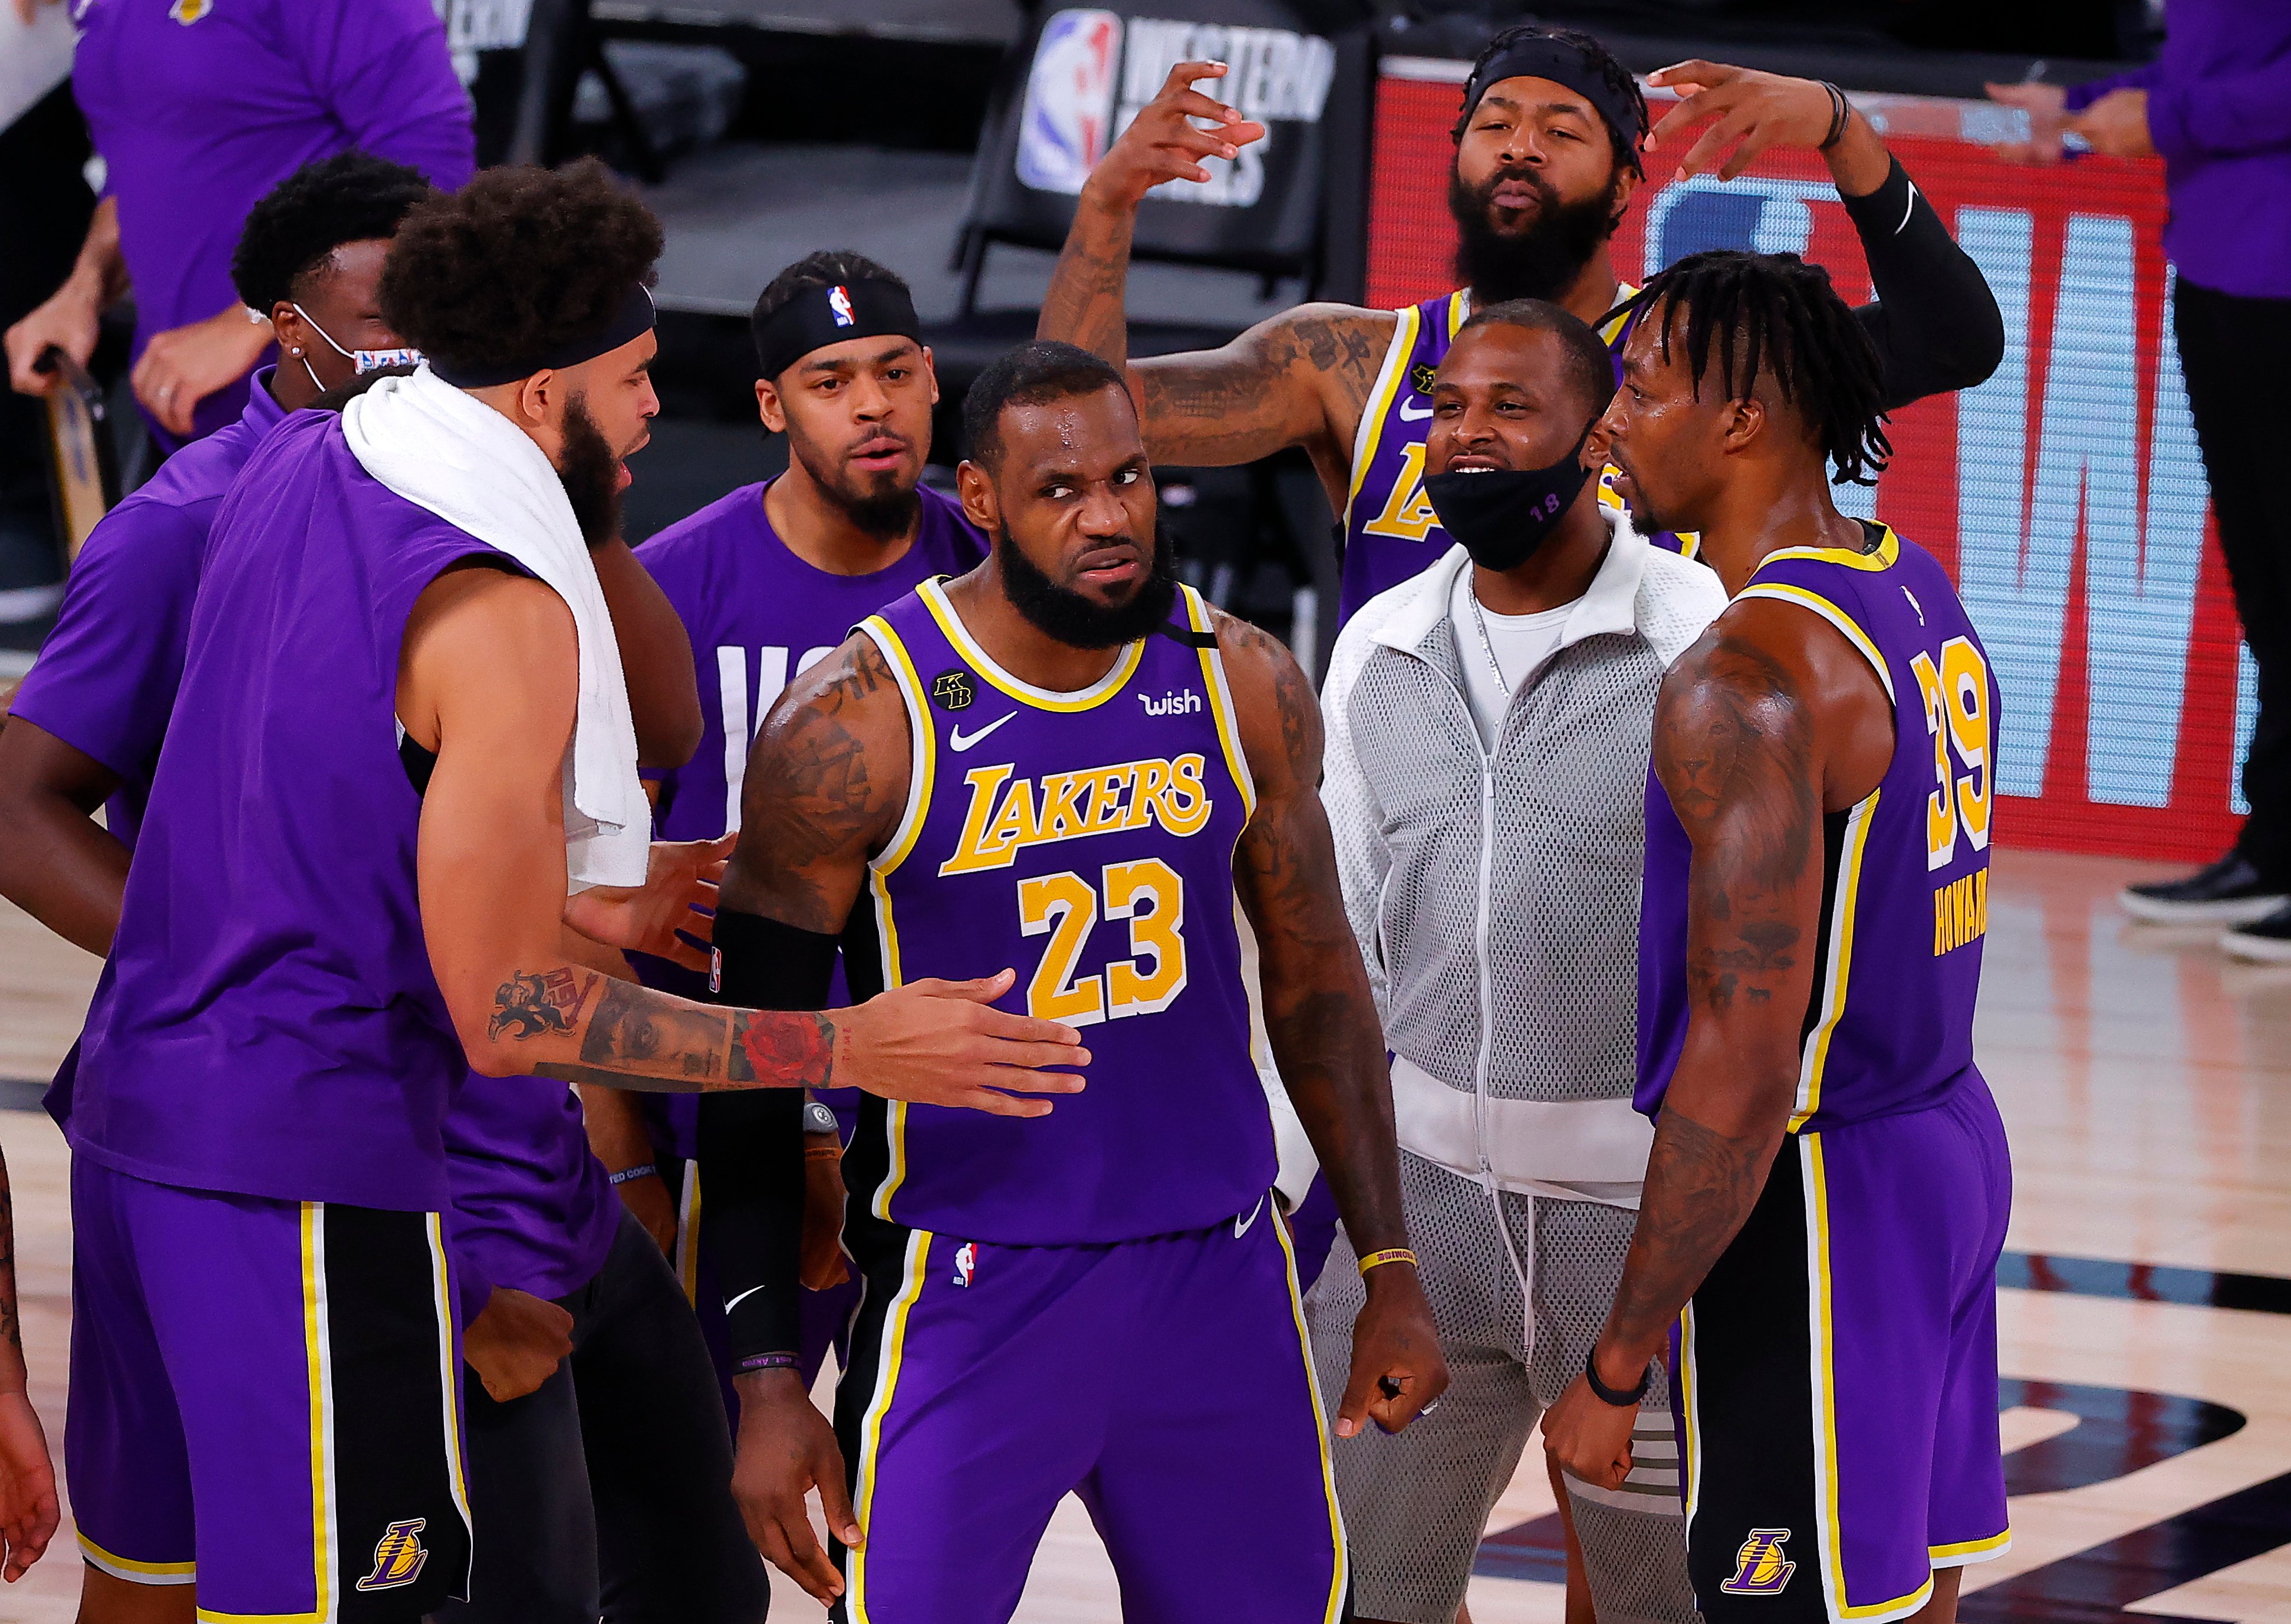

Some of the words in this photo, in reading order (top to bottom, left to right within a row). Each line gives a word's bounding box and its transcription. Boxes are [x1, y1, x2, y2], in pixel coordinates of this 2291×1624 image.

[1530, 493, 1559, 522] 18
[1138, 689, 1201, 716] wish
[1910, 635, 1991, 871] 39
[938, 753, 1213, 877] LAKERS
[1017, 857, 1187, 1028] 23
